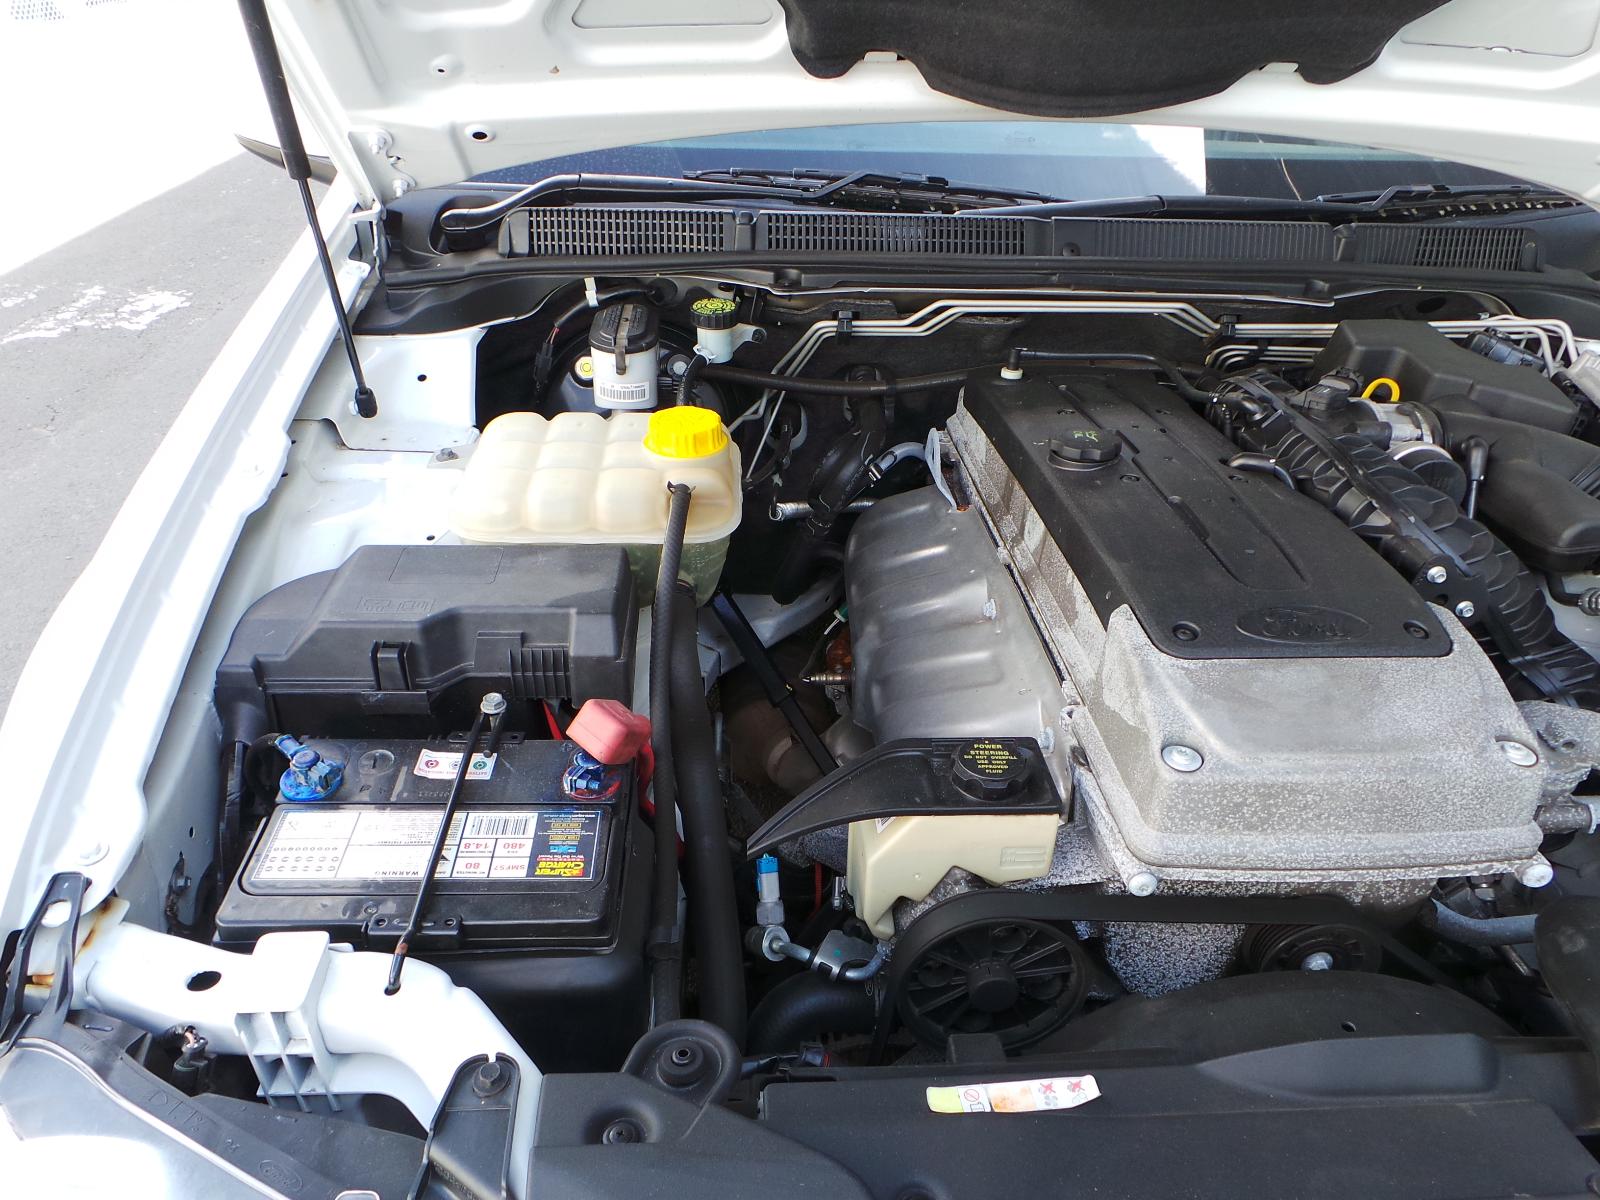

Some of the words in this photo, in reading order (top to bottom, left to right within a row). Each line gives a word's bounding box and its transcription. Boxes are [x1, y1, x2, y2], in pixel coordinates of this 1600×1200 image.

[463, 842, 489, 850] 14.8
[503, 842, 526, 850] 480
[465, 862, 480, 870] 80
[539, 861, 584, 869] CHARGE
[535, 868, 572, 877] SUPER
